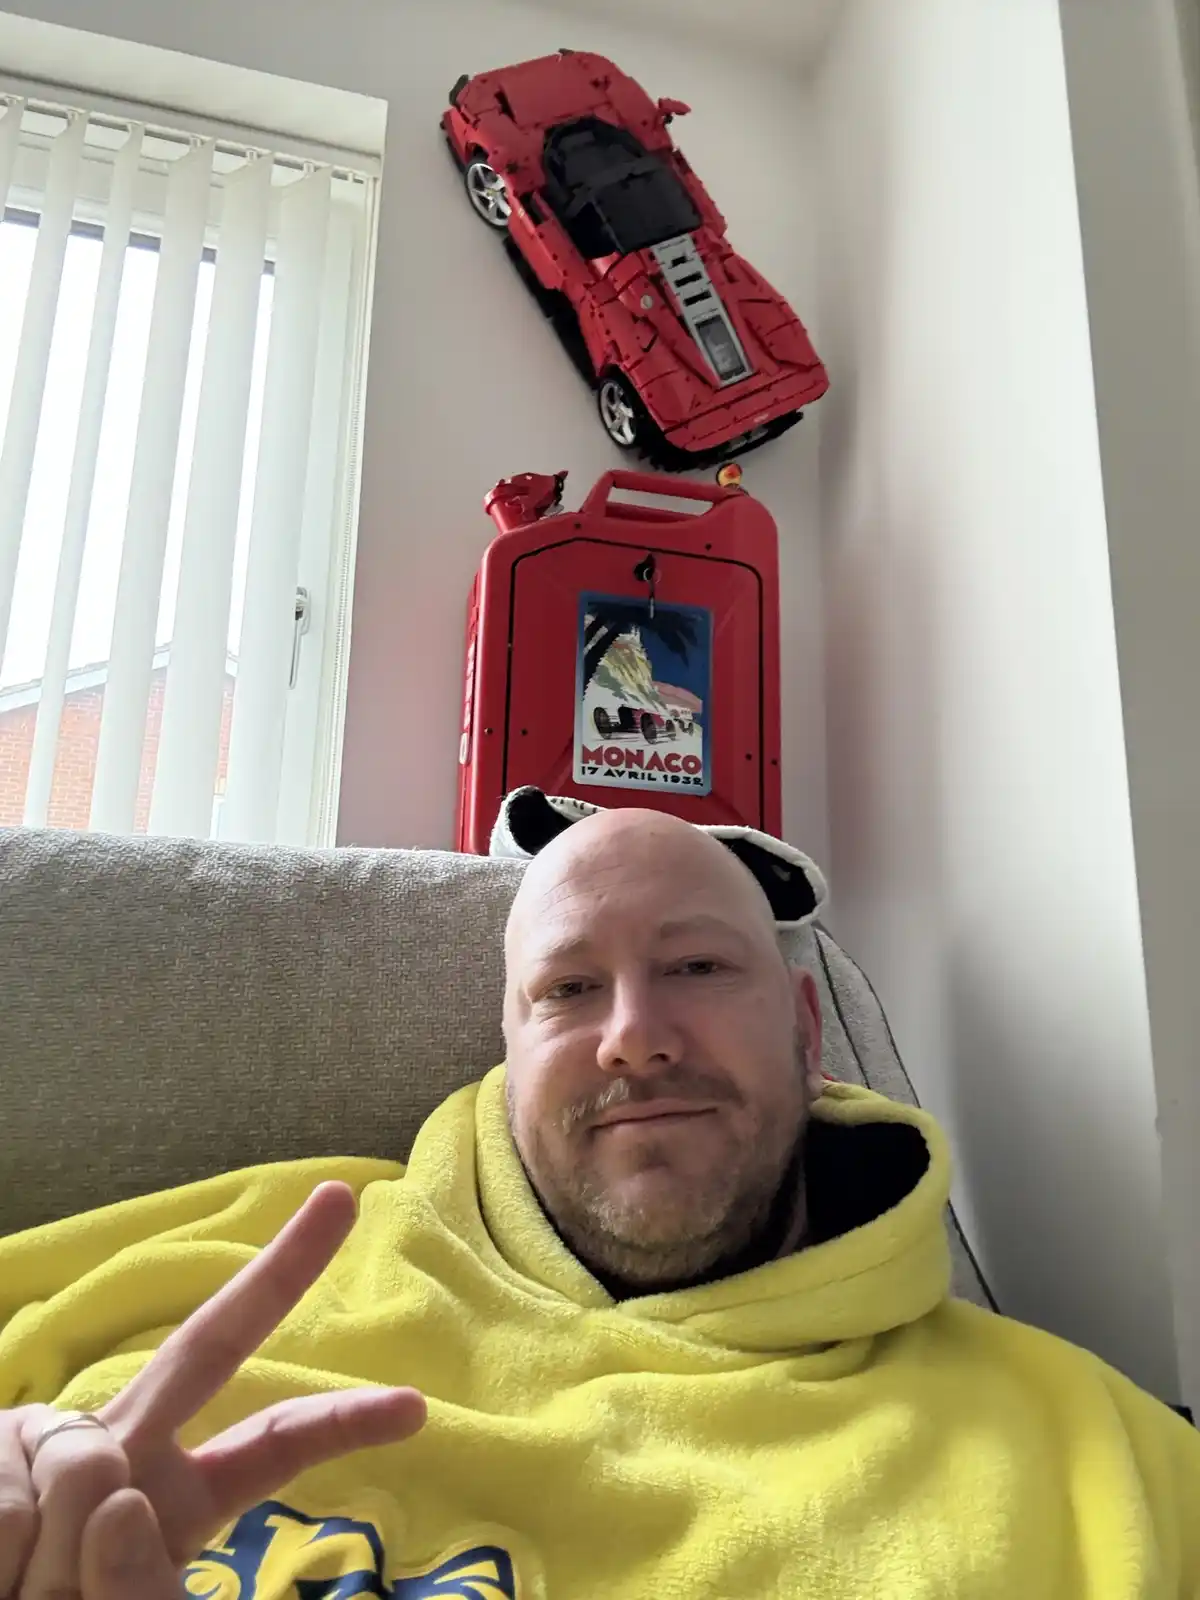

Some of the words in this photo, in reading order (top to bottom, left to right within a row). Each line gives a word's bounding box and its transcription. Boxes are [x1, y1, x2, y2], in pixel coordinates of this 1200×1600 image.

[582, 745, 702, 775] MONACO
[581, 766, 598, 776] 17
[603, 768, 657, 781] AVRIL
[663, 774, 704, 787] 1932
